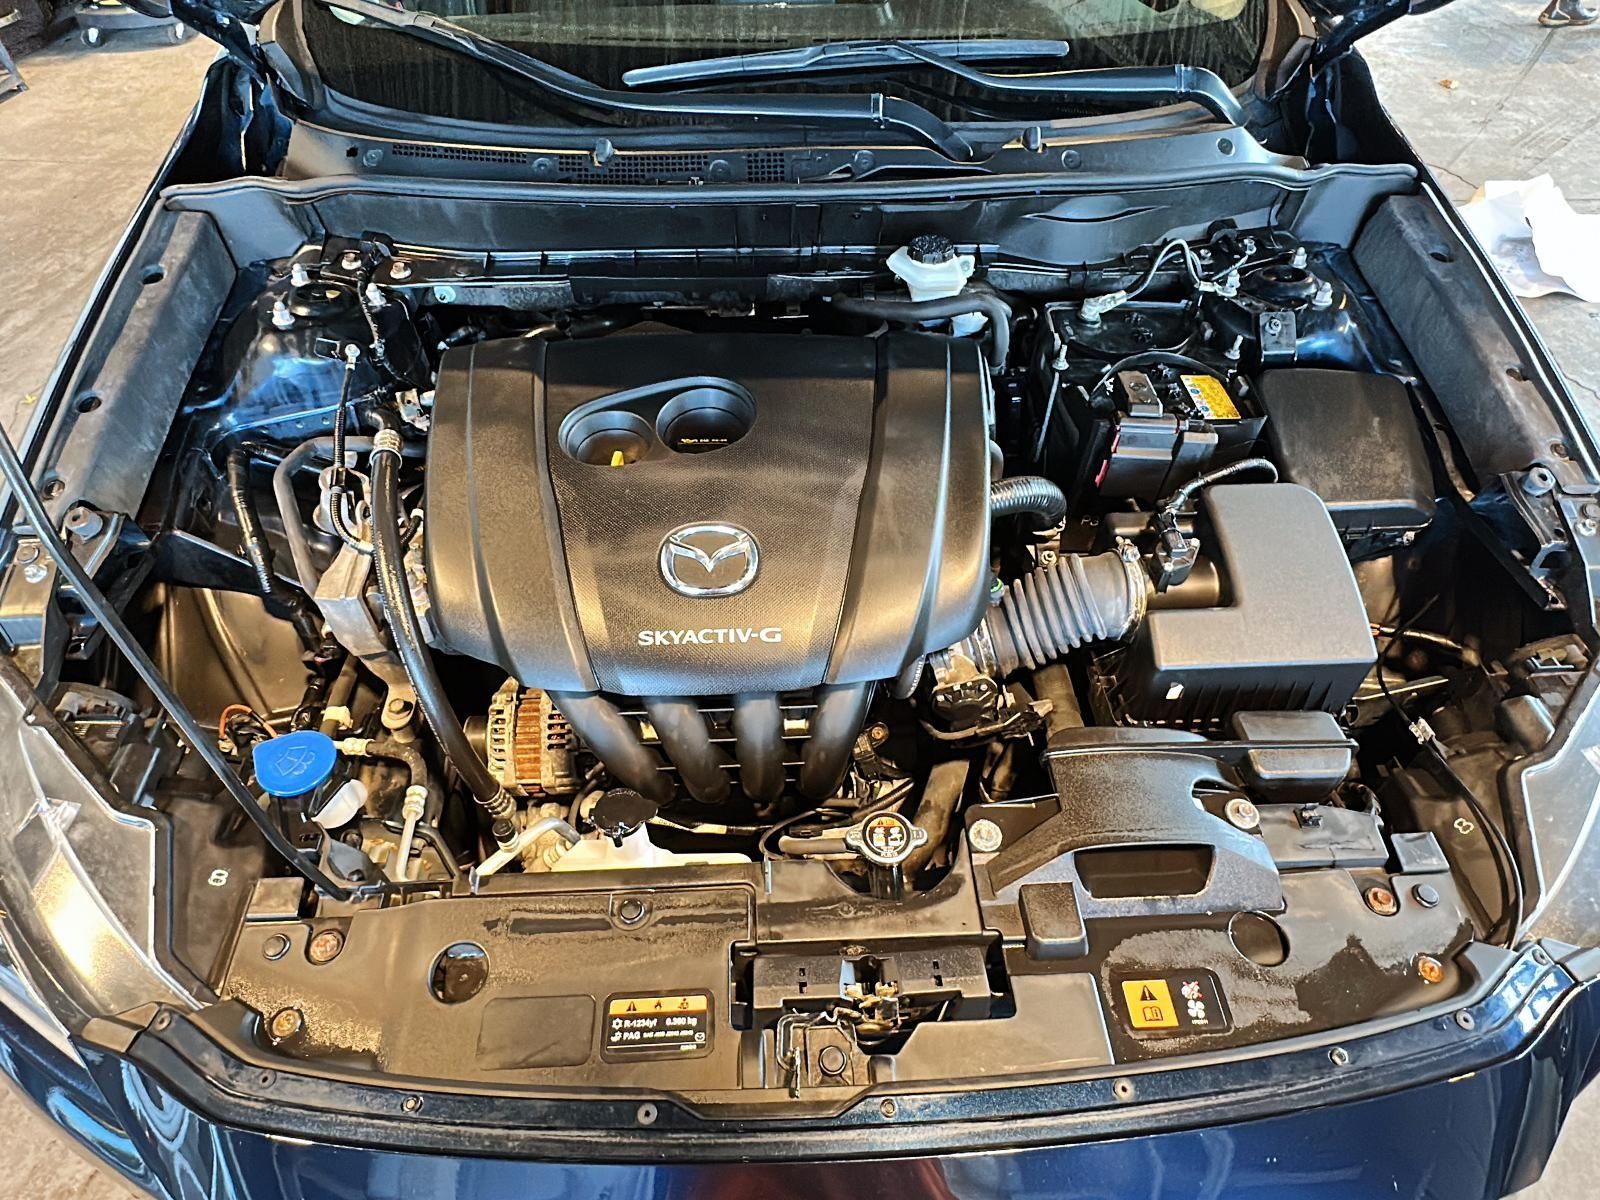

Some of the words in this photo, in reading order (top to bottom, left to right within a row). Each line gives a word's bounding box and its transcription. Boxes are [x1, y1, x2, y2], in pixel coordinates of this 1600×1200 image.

[638, 627, 782, 646] SKYACTIV-G
[624, 1018, 658, 1028] R-1234yf
[687, 1016, 697, 1027] kg
[623, 1031, 640, 1040] PAG
